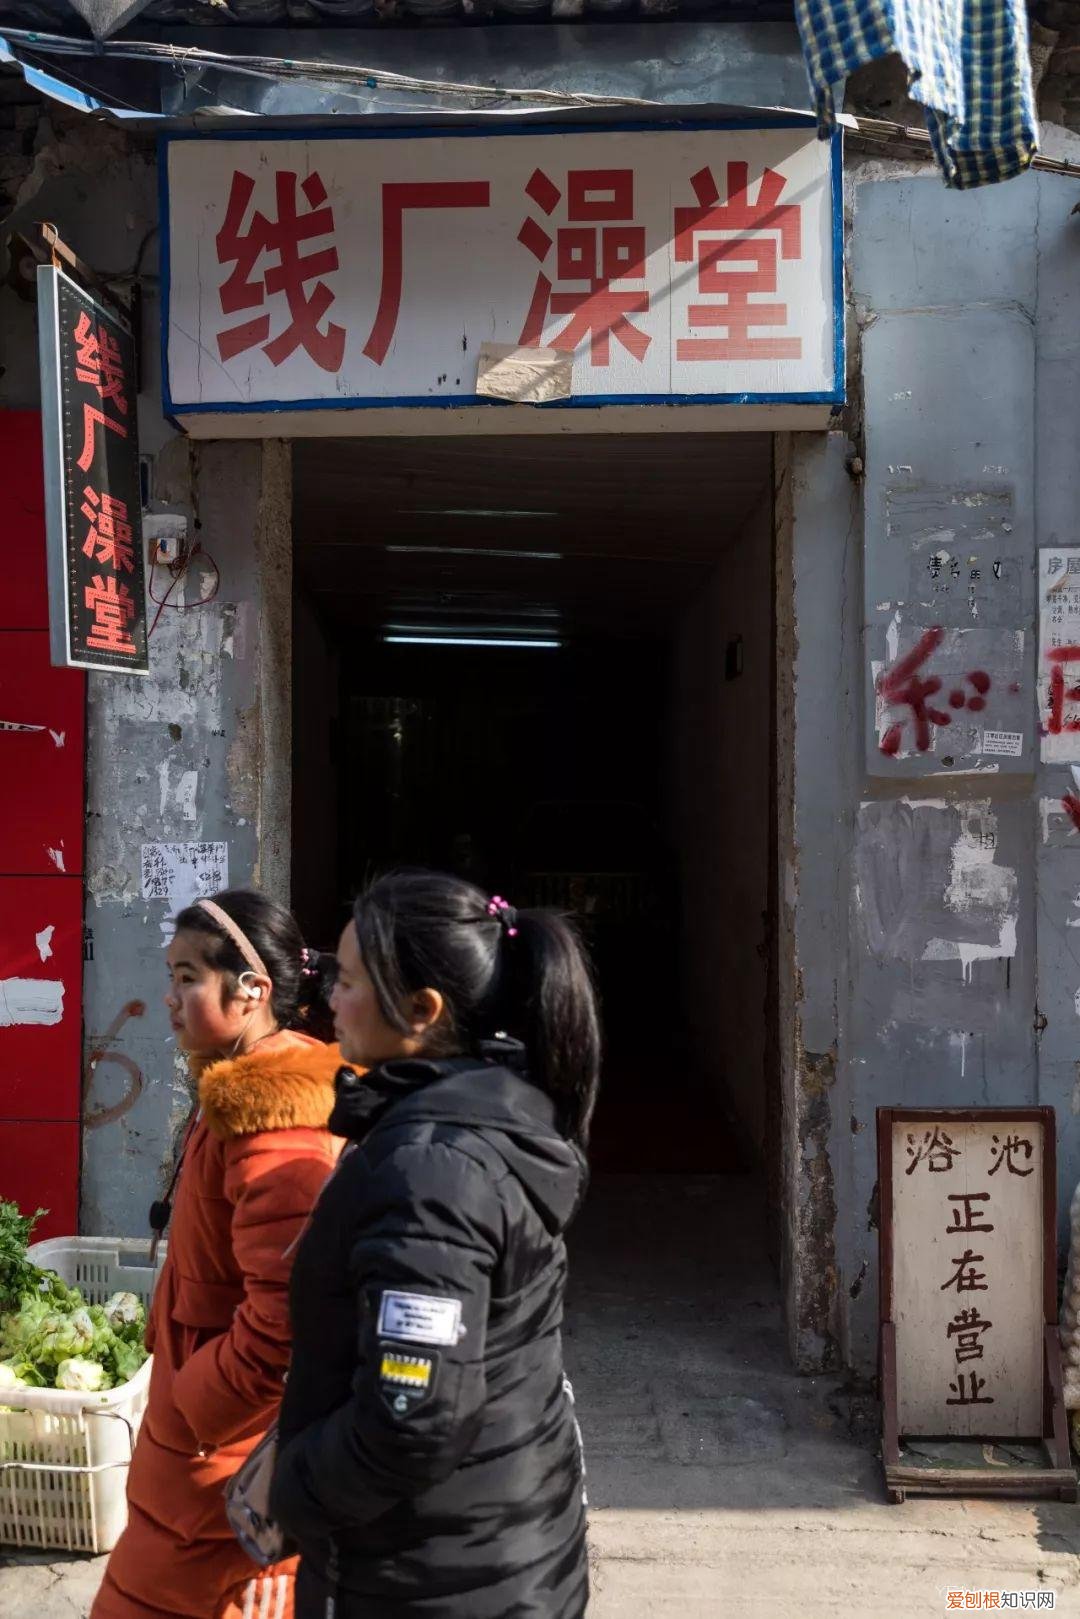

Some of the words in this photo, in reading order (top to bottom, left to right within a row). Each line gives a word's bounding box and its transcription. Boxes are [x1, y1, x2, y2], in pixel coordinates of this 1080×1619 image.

[216, 161, 802, 373] 线厂澡堂
[73, 311, 137, 654] 线厂澡堂
[905, 1125, 1035, 1177] 浴池
[940, 1191, 995, 1406] 正在营业
